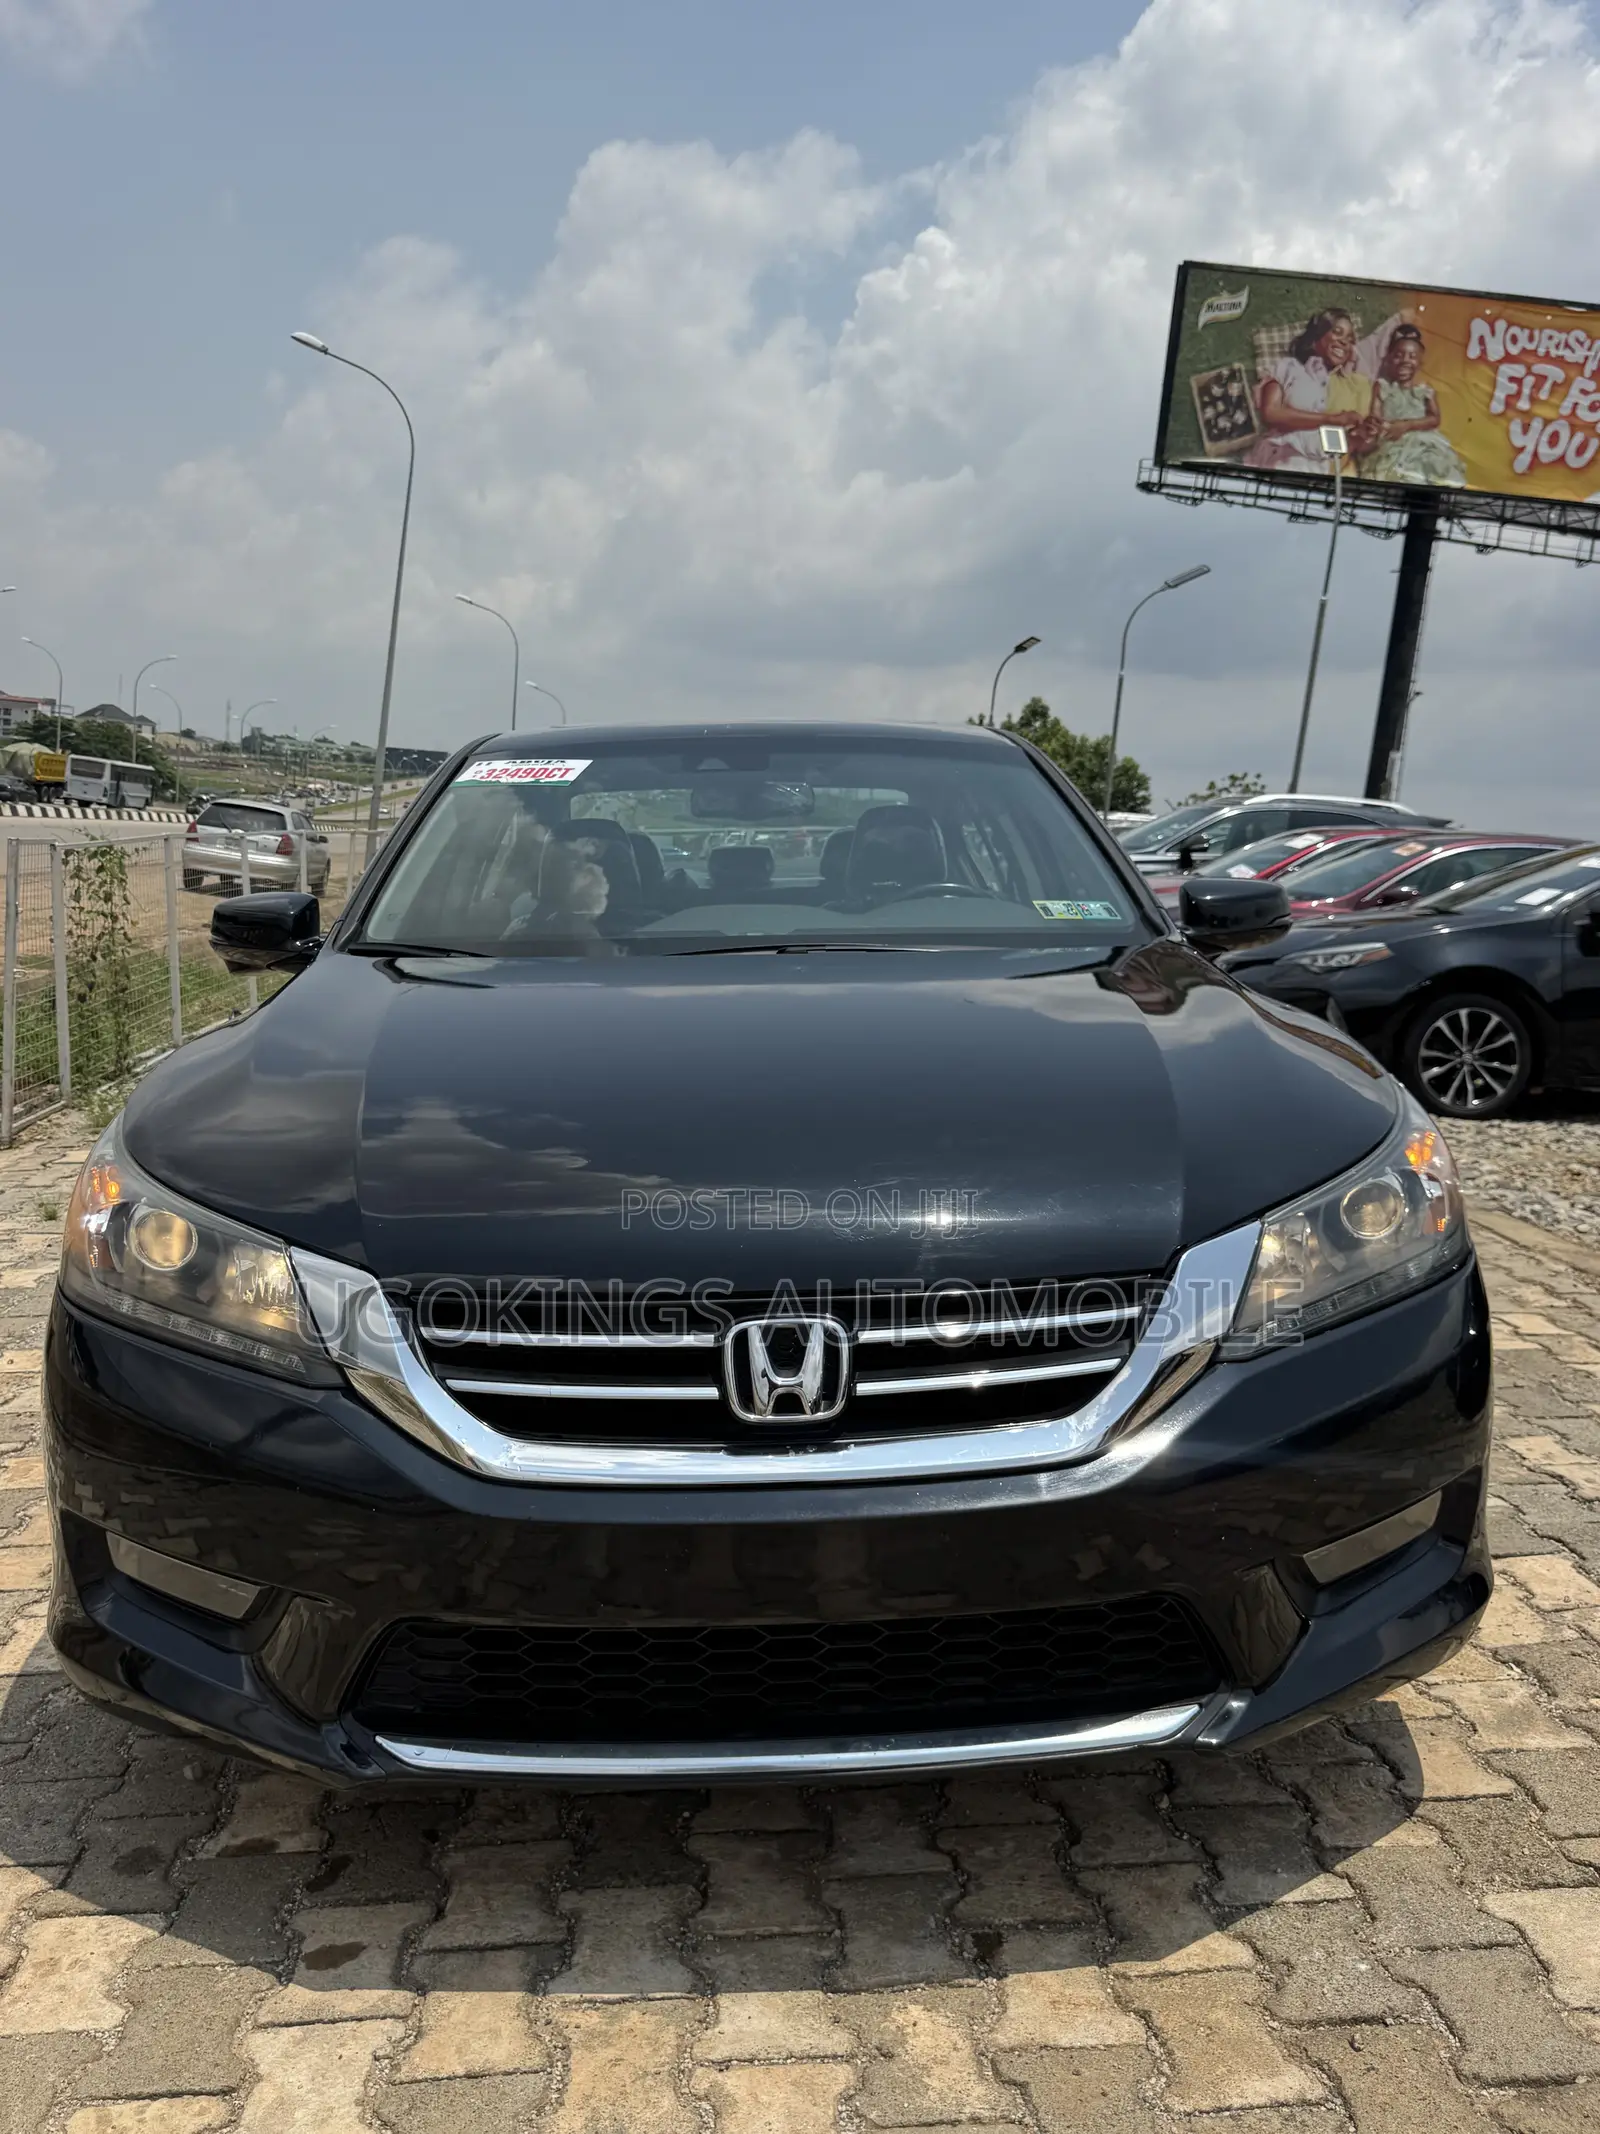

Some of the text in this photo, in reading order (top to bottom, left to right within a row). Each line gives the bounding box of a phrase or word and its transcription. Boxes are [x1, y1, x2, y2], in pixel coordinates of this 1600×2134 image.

[1490, 363, 1600, 434] FIT FO
[1509, 416, 1600, 474] YOU
[479, 768, 576, 779] 3249DCT
